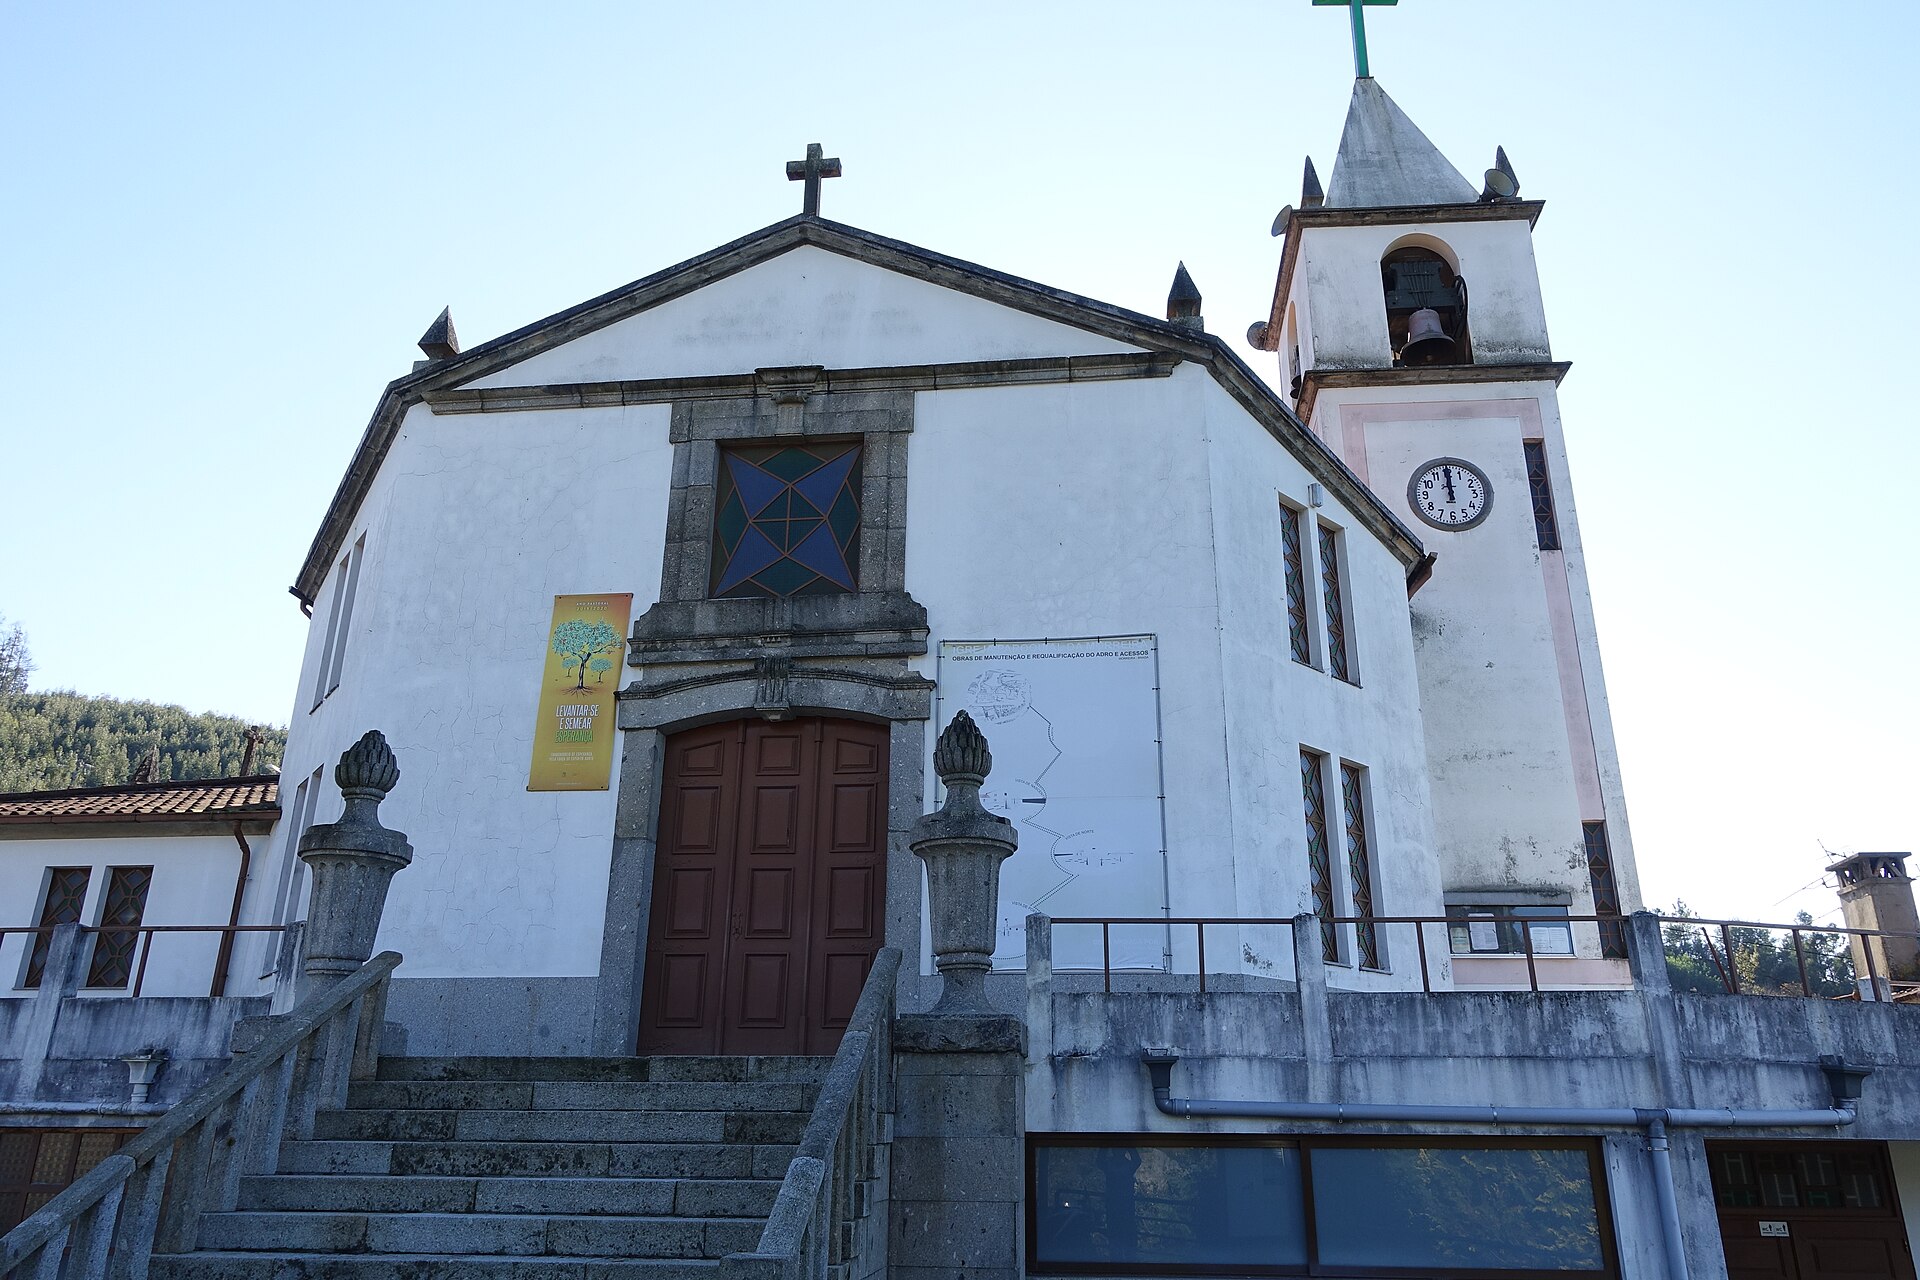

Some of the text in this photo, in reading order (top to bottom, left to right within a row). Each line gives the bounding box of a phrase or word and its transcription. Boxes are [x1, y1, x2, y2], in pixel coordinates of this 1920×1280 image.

[1432, 472, 1440, 481] 11
[1457, 471, 1462, 480] 1
[1423, 480, 1434, 489] 10
[1467, 478, 1474, 488] 2
[1422, 490, 1429, 500] 9
[1471, 489, 1478, 499] 3
[1427, 502, 1434, 511] 8
[1469, 500, 1476, 510] 4
[1438, 509, 1444, 519] 7
[1449, 511, 1456, 520] 6
[1461, 508, 1468, 518] 5
[1032, 651, 1085, 660] REQUALIFICAÇÃO
[556, 704, 600, 717] LEVANTAR-SE
[559, 717, 592, 730] E SEMEAR
[554, 730, 593, 744] ESPERANÇA
